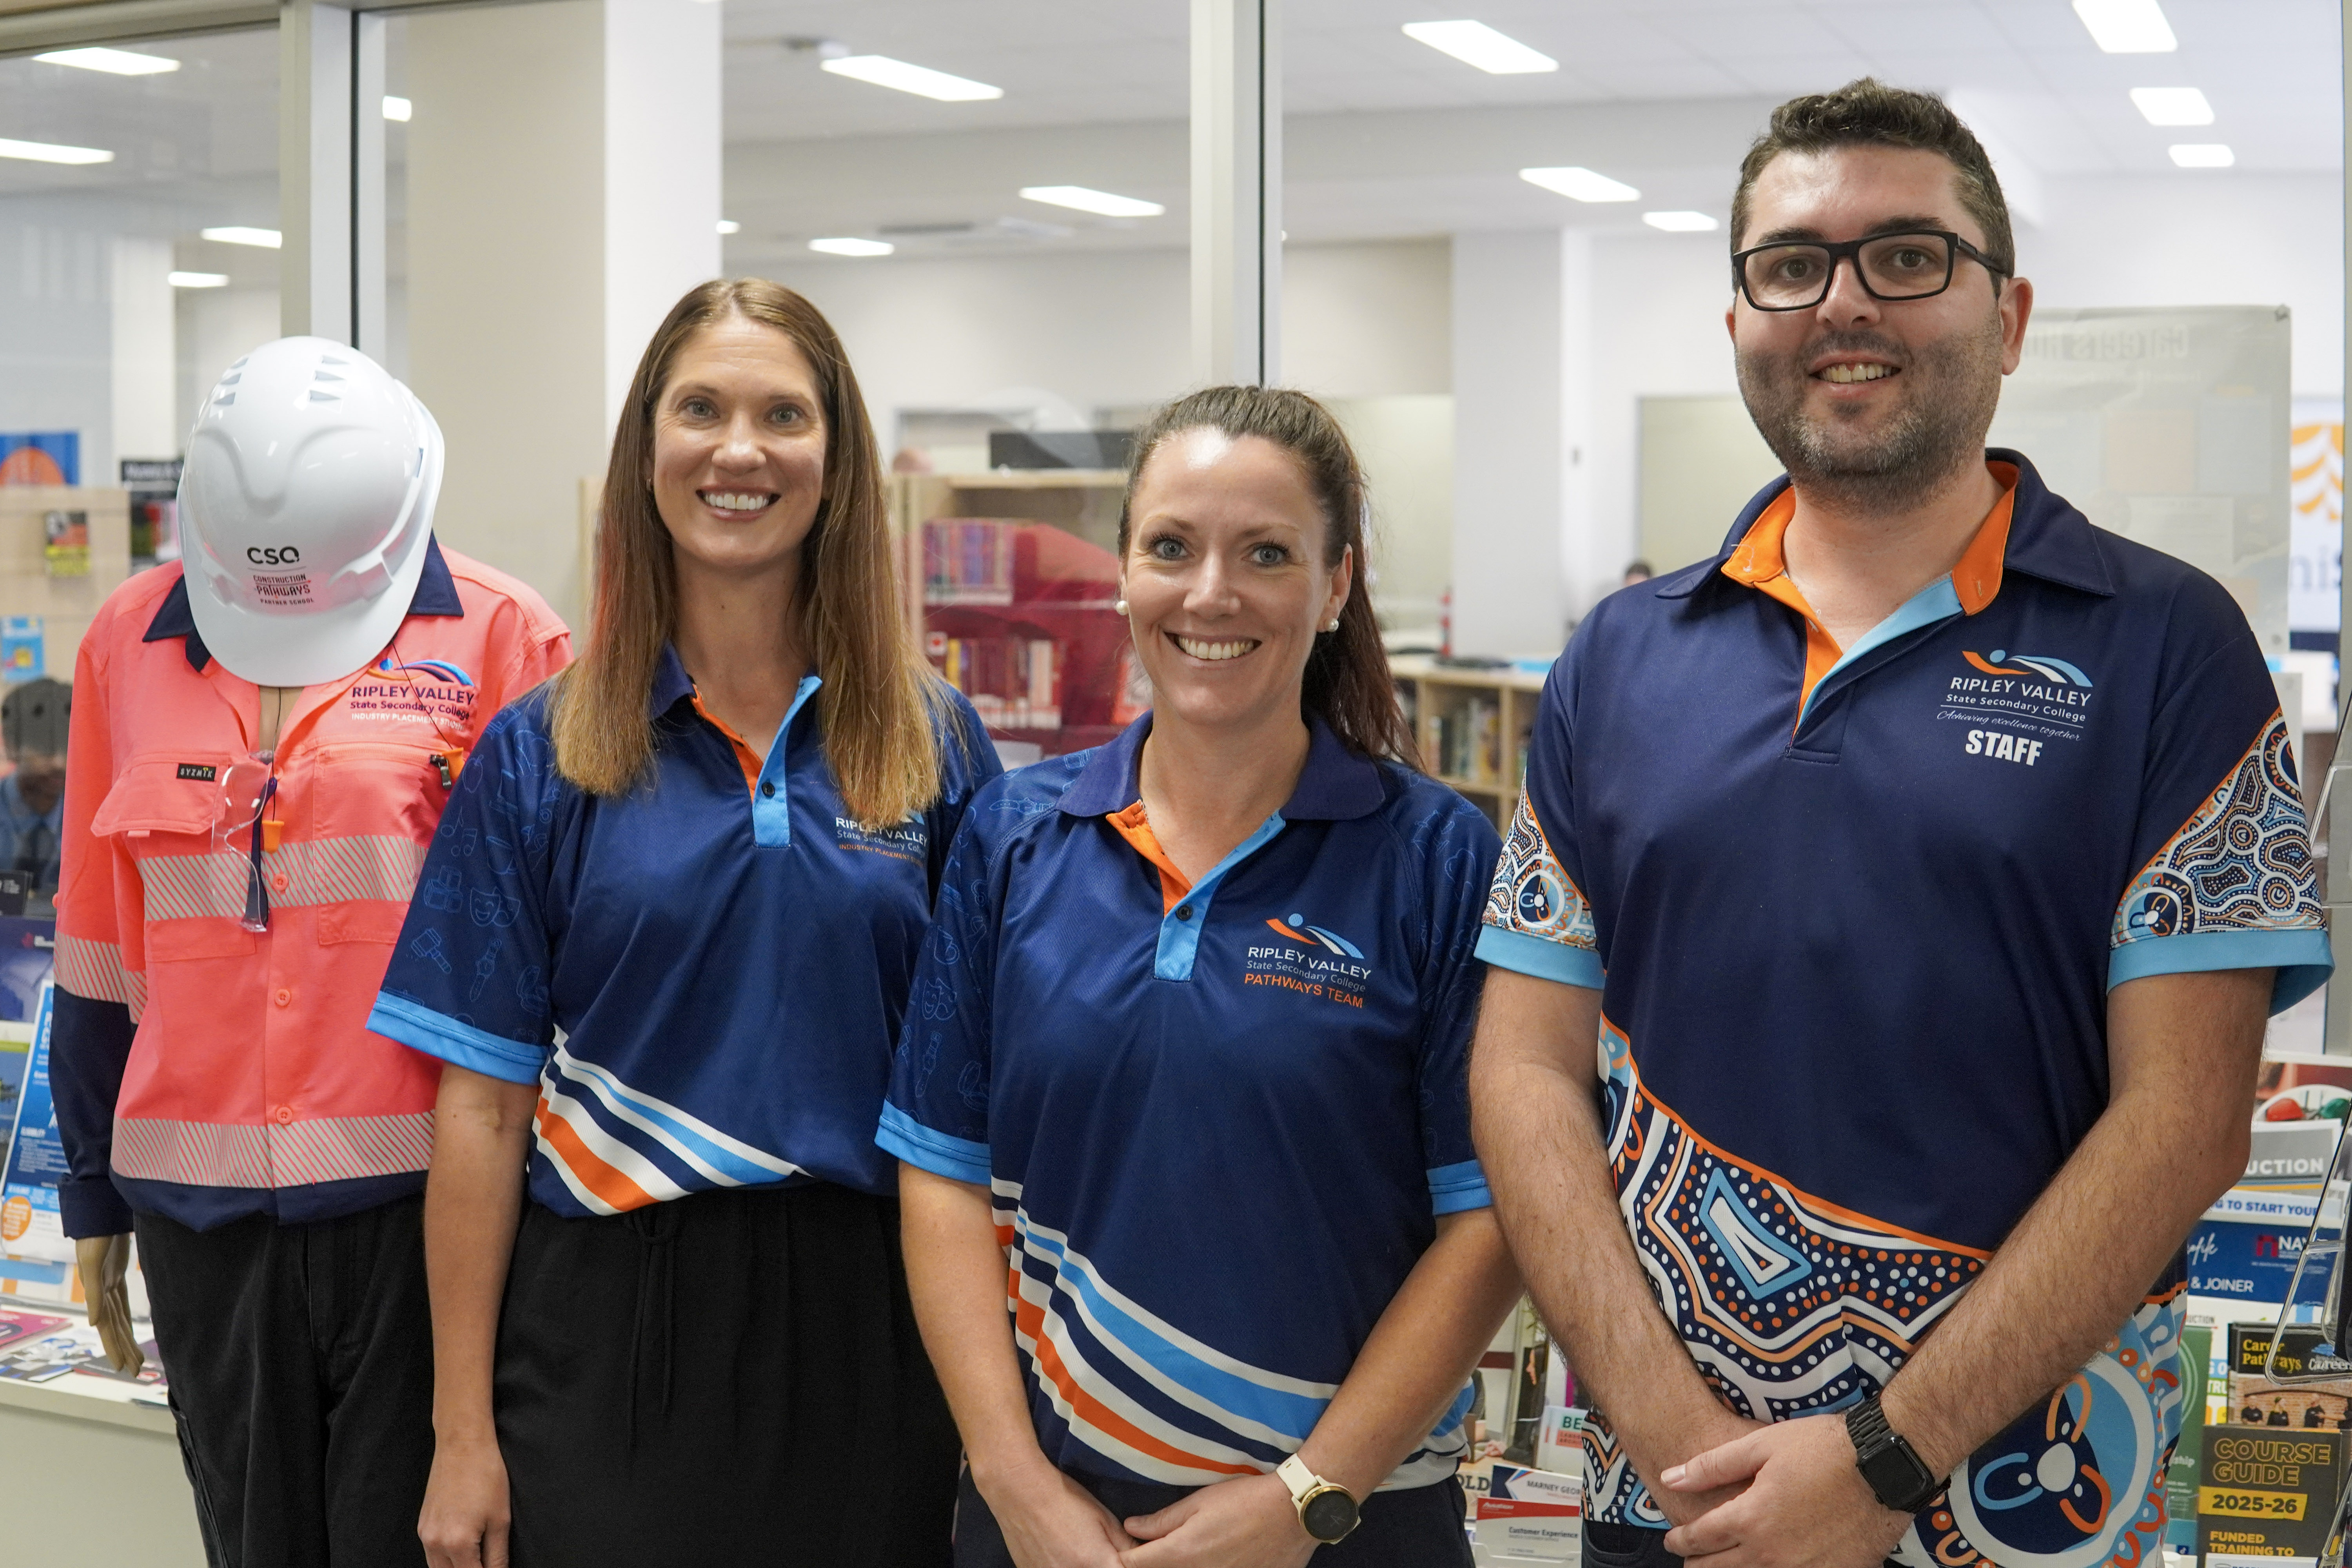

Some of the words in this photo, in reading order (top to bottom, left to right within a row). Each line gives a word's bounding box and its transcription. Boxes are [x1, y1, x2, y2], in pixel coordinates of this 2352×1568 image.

[253, 573, 306, 584] CONSTRUCTION
[256, 584, 310, 597] PATHWAYS
[289, 597, 314, 606] SCHOOL
[352, 686, 409, 697] RIPLEY
[415, 686, 474, 705] VALLEY
[1950, 677, 2015, 693] RIPLEY
[2022, 683, 2091, 706] VALLEY
[381, 701, 434, 714] Secondary
[438, 704, 470, 720] College
[1946, 694, 1976, 704] State
[1980, 697, 2040, 713] Secondary
[2043, 706, 2086, 722] College
[392, 714, 438, 724] PLACEMENT
[1937, 710, 1989, 725] Achieving
[1991, 718, 2037, 731] excellence
[2040, 726, 2082, 741] together
[1965, 729, 2043, 766] STAFF
[180, 767, 213, 778] SYZMIK
[837, 830, 860, 840] State
[864, 833, 905, 851] Secondary
[886, 829, 927, 847] VALLEY
[839, 844, 873, 852] INDUSTRY
[1248, 947, 1305, 963] RIPLEY
[1308, 957, 1371, 980] VALLEY
[1247, 960, 1272, 969] State
[1276, 962, 1327, 982] Secondary
[1331, 975, 1366, 993] College
[1245, 973, 1322, 996] PATHWAYS
[1327, 987, 1363, 1008] TEAM
[2227, 1200, 2241, 1210] TO
[2245, 1202, 2284, 1214] START
[2190, 1276, 2201, 1289] &
[2204, 1277, 2254, 1293] JOINER
[2214, 1437, 2331, 1465] COURSE
[2213, 1461, 2299, 1486] GUIDE
[2212, 1494, 2297, 1514] 2025-26
[2210, 1531, 2265, 1543] FUNDED
[2210, 1543, 2274, 1556] TRAINING
[2276, 1547, 2295, 1557] TO
